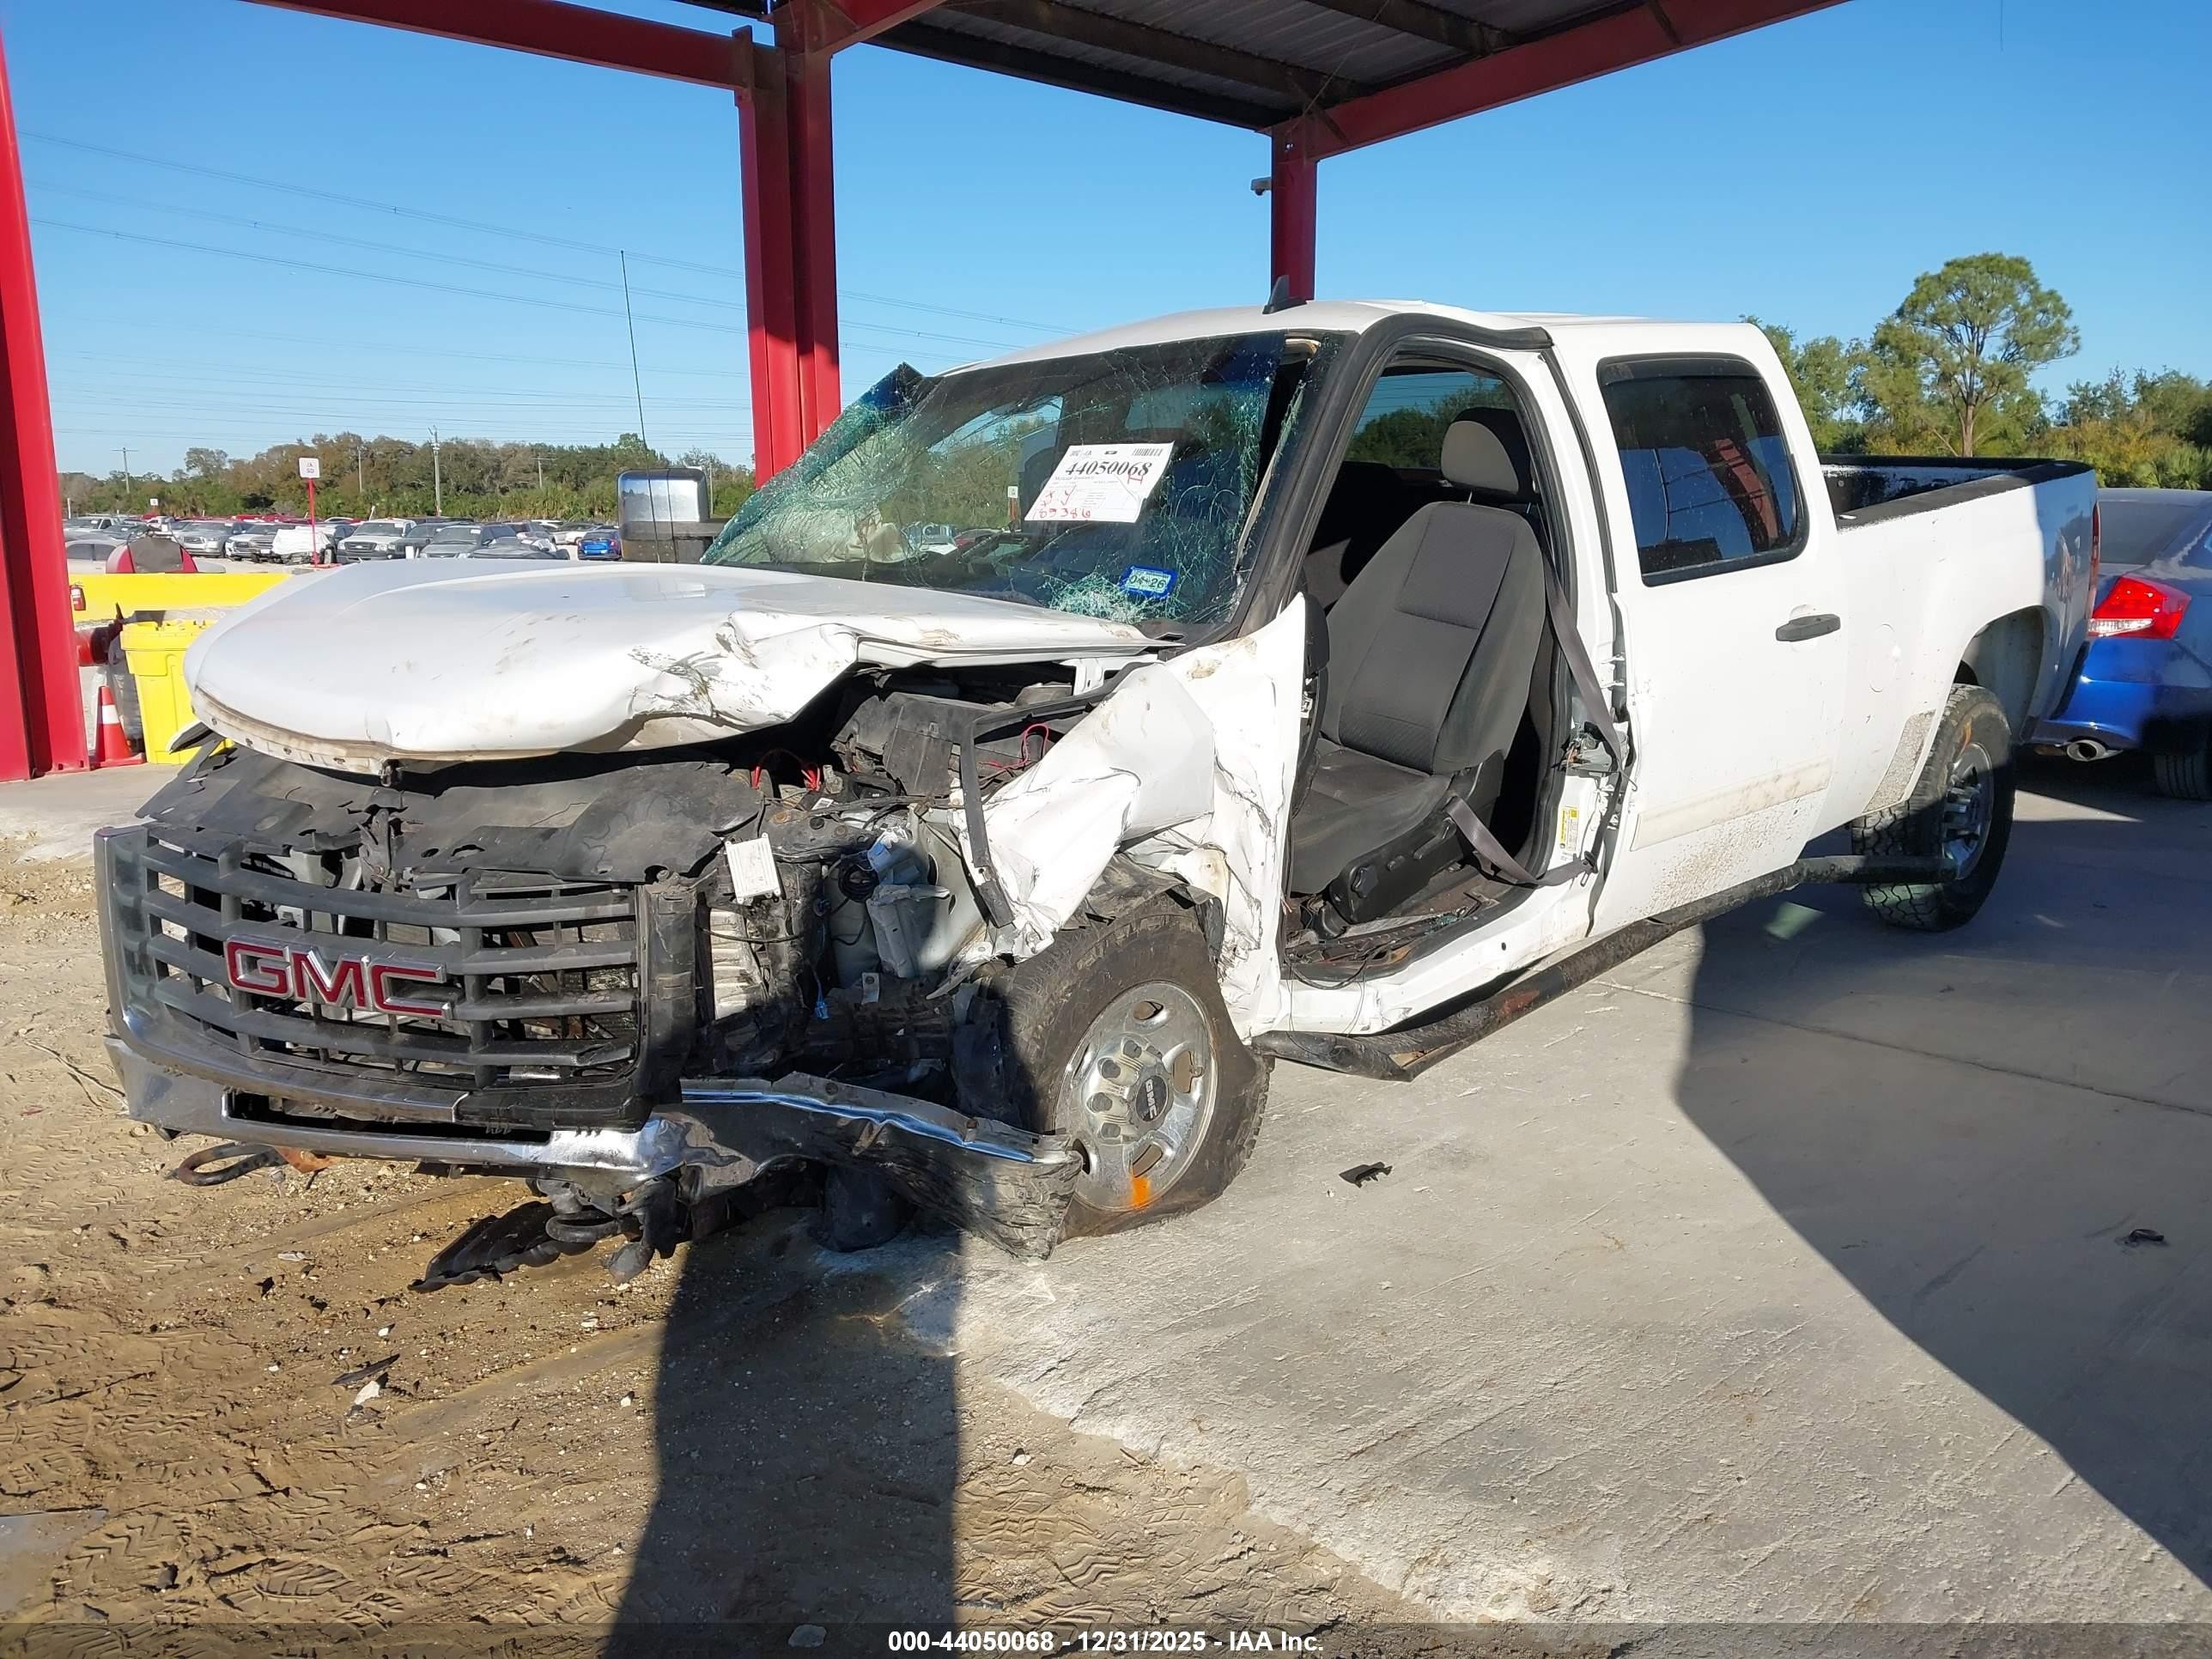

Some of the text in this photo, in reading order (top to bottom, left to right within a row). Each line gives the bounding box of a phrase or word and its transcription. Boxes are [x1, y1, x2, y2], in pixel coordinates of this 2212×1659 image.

[1066, 461, 1152, 476] 44050068
[226, 934, 453, 1019] GMC
[1146, 1079, 1157, 1118] GMC
